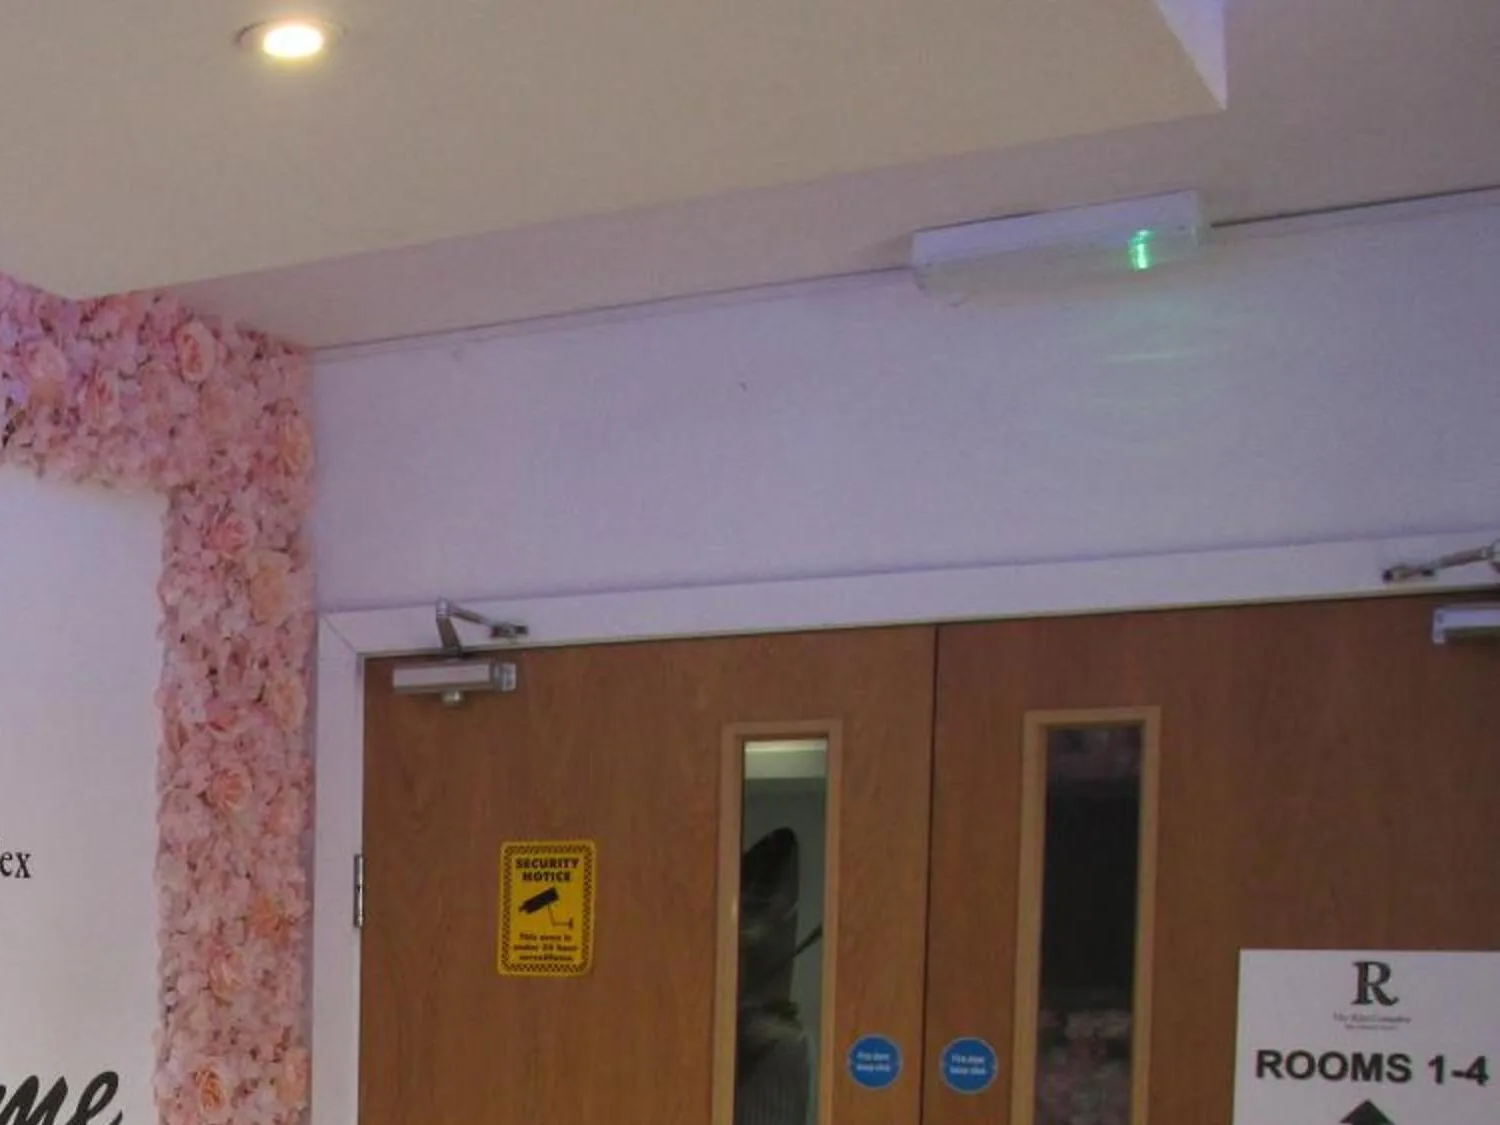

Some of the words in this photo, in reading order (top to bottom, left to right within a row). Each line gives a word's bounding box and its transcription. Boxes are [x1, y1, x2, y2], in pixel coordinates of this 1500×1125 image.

[515, 857, 579, 868] SECURITY
[522, 871, 570, 882] NOTICE
[1351, 961, 1399, 1006] R
[1255, 1049, 1412, 1083] ROOMS
[1428, 1054, 1489, 1087] 1-4
